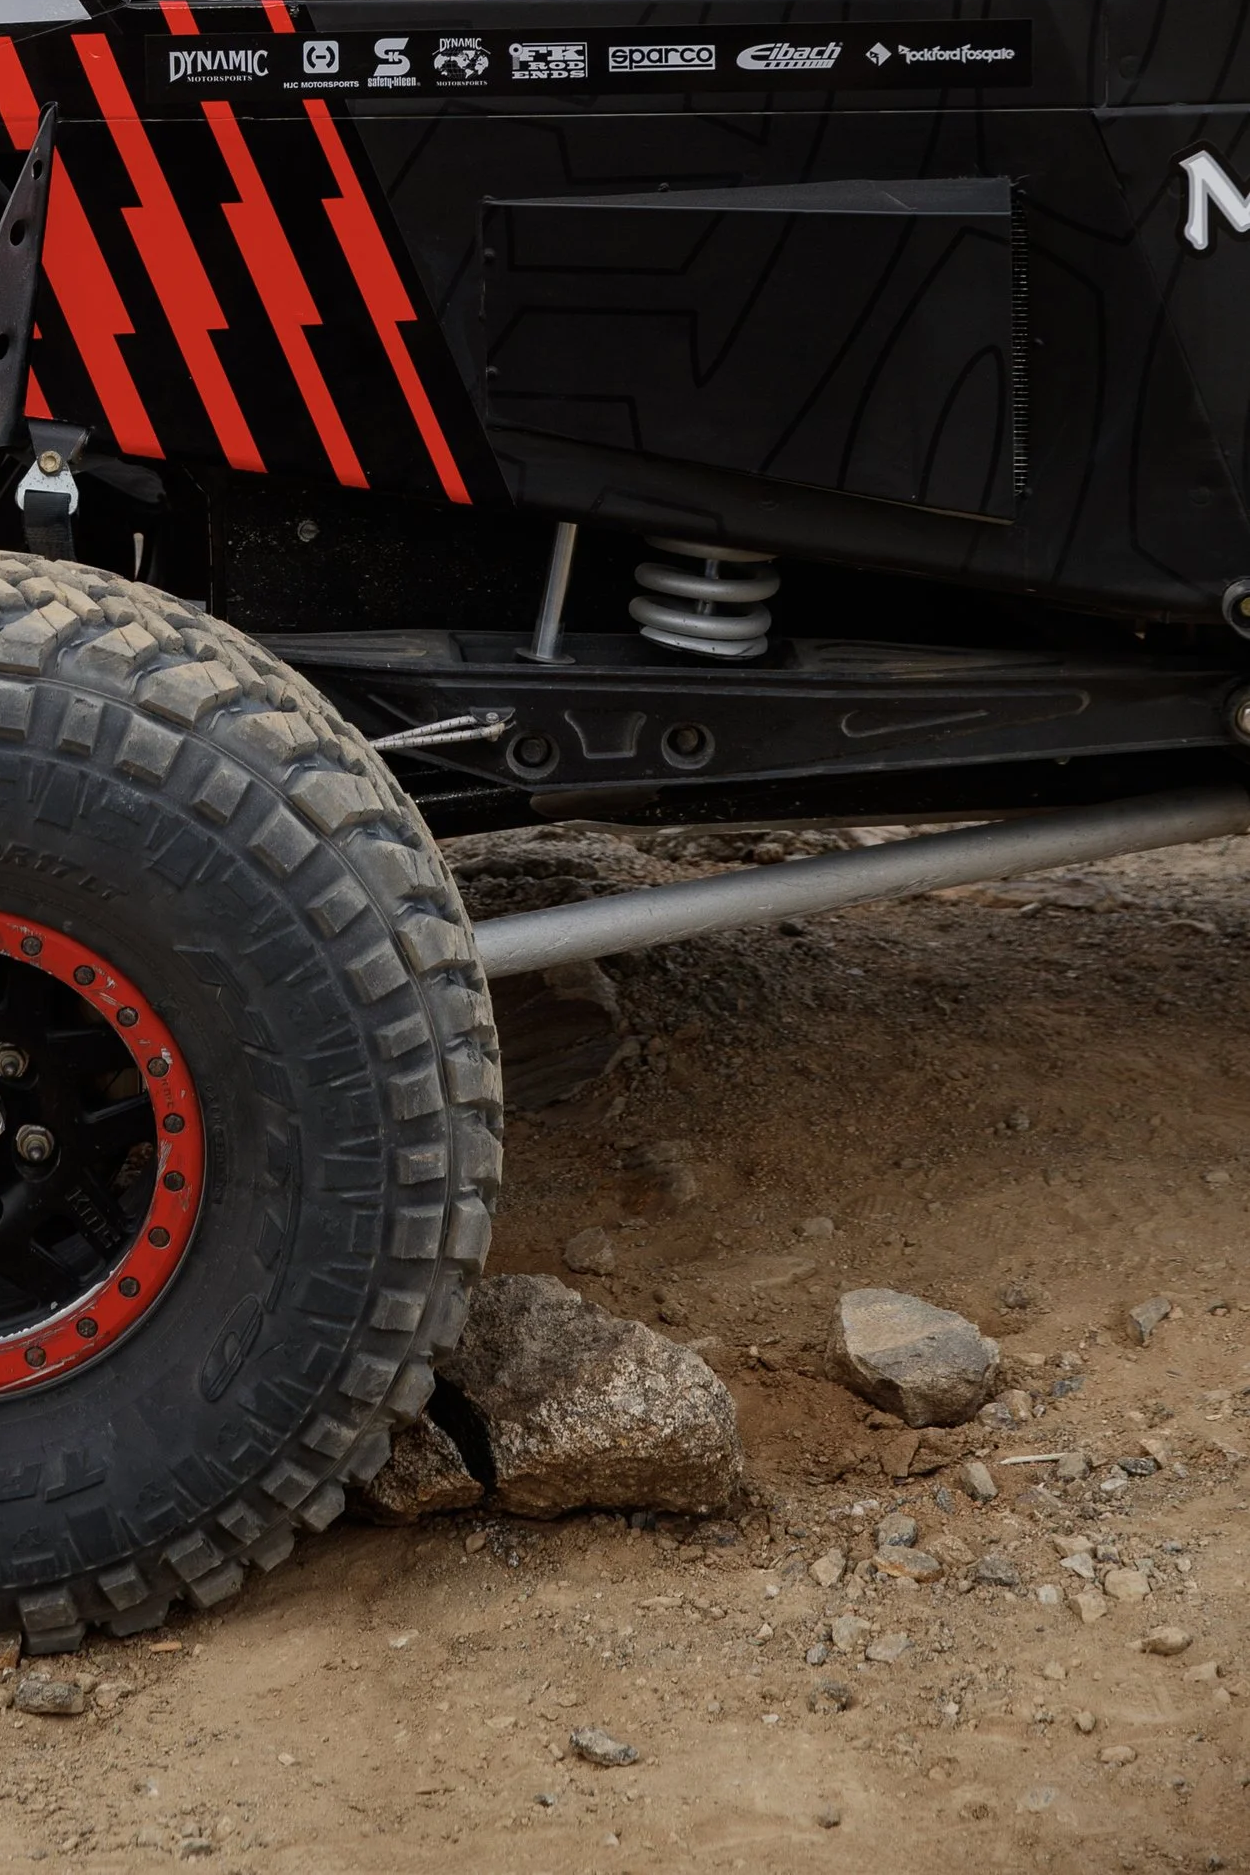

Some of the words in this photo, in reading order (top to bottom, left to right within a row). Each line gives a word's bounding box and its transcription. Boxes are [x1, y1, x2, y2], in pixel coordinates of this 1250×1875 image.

[439, 37, 482, 52] DYNAMIC
[520, 45, 584, 61] FK
[611, 47, 713, 70] sparco
[736, 42, 842, 69] Eibach
[898, 44, 960, 64] Rockford
[961, 44, 1015, 64] Fosgate
[169, 49, 269, 83] DYNAMIC
[528, 61, 585, 70] ROD
[187, 75, 253, 83] MOTORSPORTS
[512, 70, 585, 79] ENDS
[301, 81, 359, 89] MOTORSPORTS
